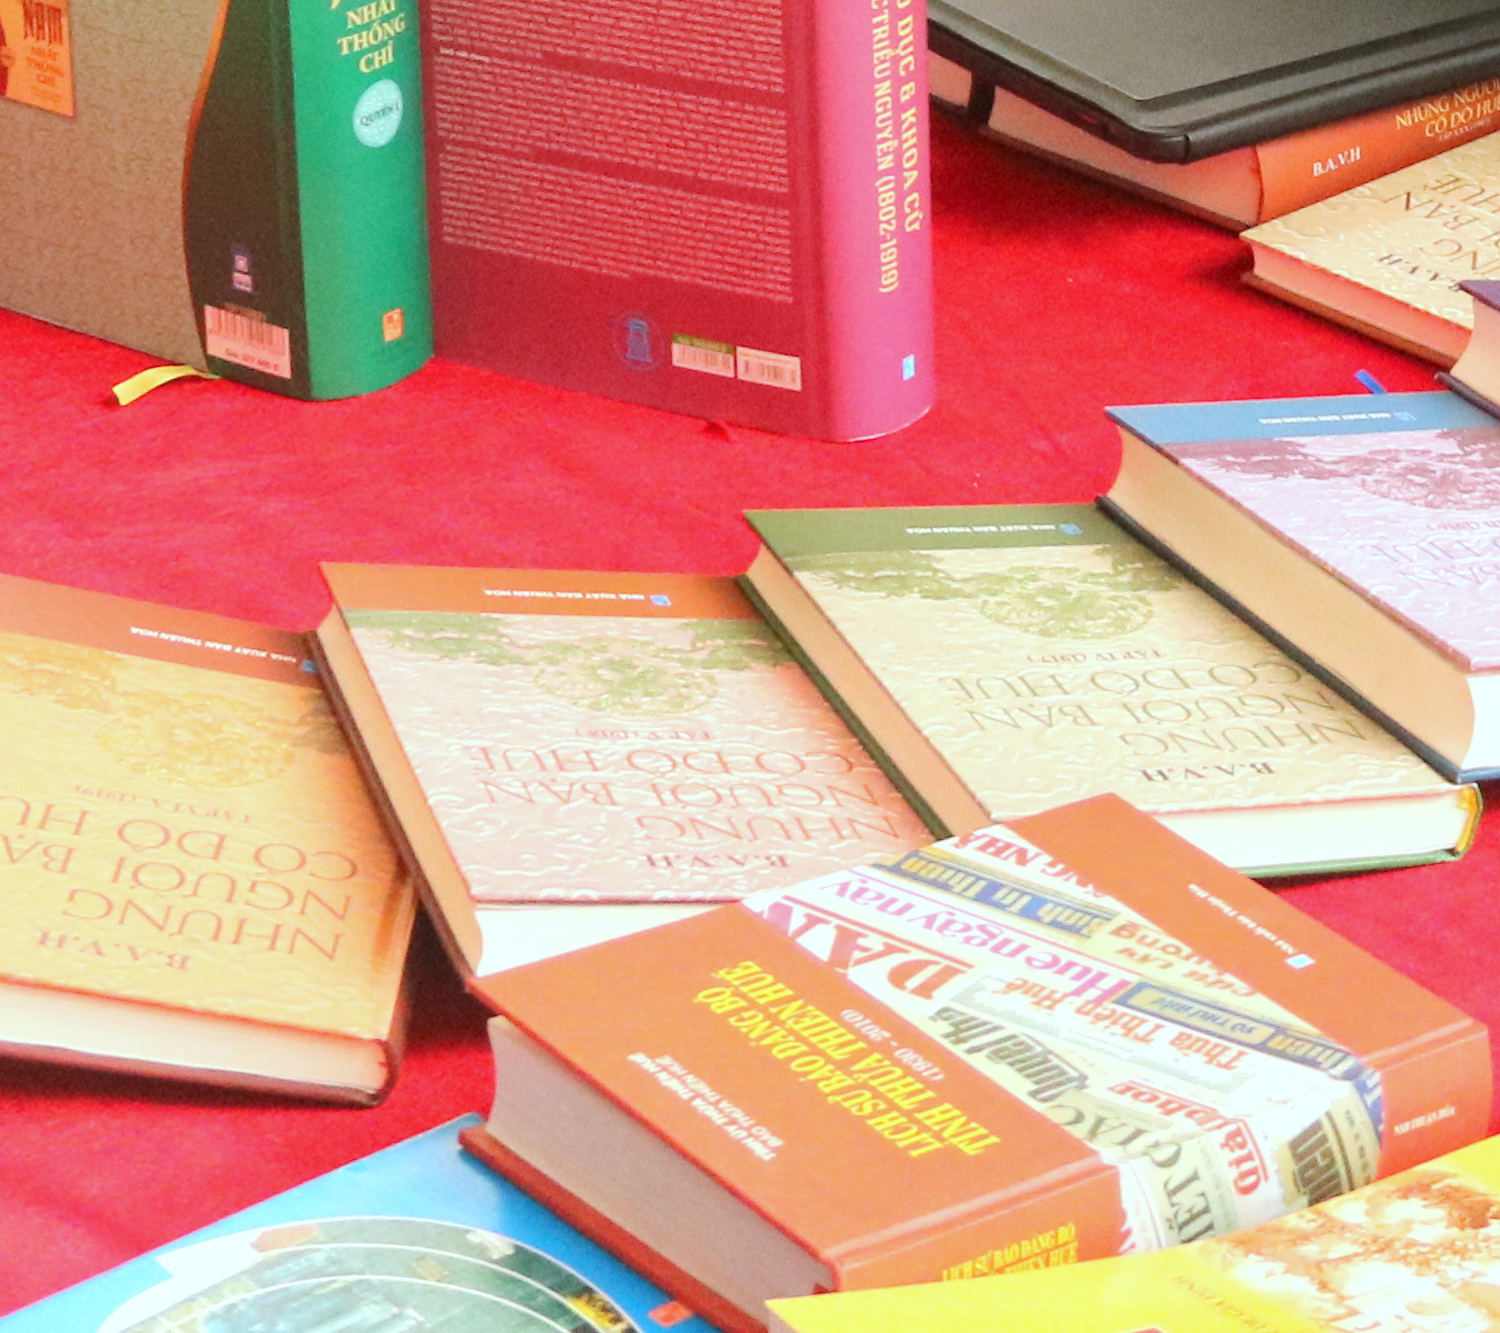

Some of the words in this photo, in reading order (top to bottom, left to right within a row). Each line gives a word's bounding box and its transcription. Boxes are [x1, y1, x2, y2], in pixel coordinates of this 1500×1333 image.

[336, 14, 406, 56] THỐNG
[891, 18, 918, 76] DỤC
[359, 40, 395, 74] CHÍ
[899, 87, 916, 101] &
[900, 106, 921, 188] KHOA
[903, 193, 926, 234] CỬ
[875, 176, 902, 293] (1802-1919)
[816, 878, 916, 918] nay
[36, 930, 191, 971] B.A.V.H
[904, 910, 1031, 959] ngày
[692, 986, 748, 1015] BỘ
[711, 959, 795, 1005] HUẾ
[730, 1010, 812, 1061] ĐẢNG
[774, 999, 868, 1060] THIÊN
[839, 1008, 892, 1041] 2010)
[891, 1046, 945, 1082] (1930
[1168, 1031, 1249, 1071] Thừa
[789, 1054, 850, 1094] BÁO
[847, 1051, 936, 1111] THỪA
[826, 1087, 887, 1117] SỬ
[865, 1109, 943, 1158] LỊCH
[914, 1102, 1001, 1156] TỈNH
